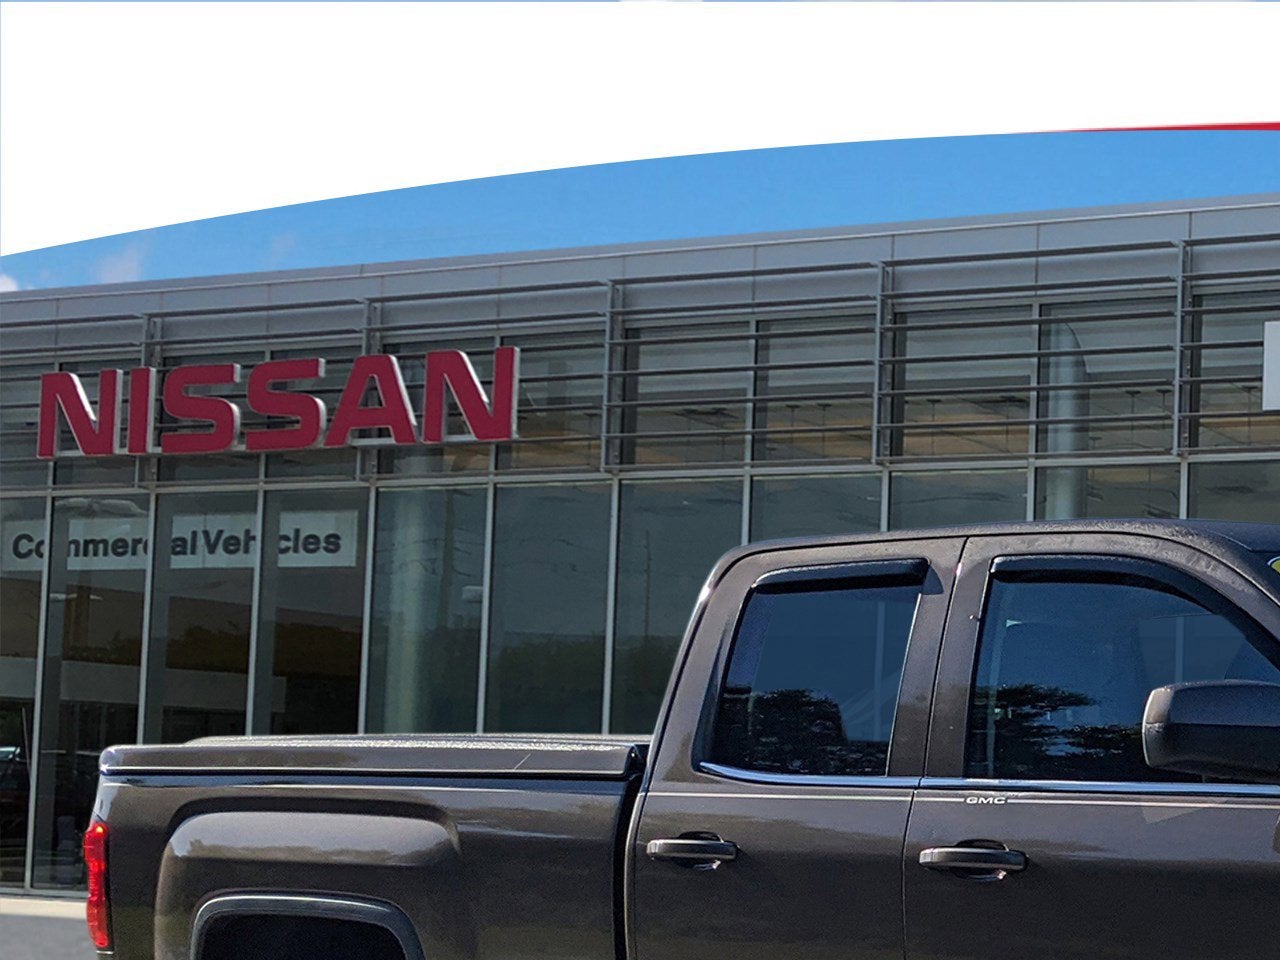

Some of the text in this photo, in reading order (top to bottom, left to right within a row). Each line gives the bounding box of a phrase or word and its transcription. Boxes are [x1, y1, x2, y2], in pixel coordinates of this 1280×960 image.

[37, 346, 520, 458] NISSAN
[12, 528, 342, 560] Comeral Vehcles
[966, 796, 1006, 805] GMC
